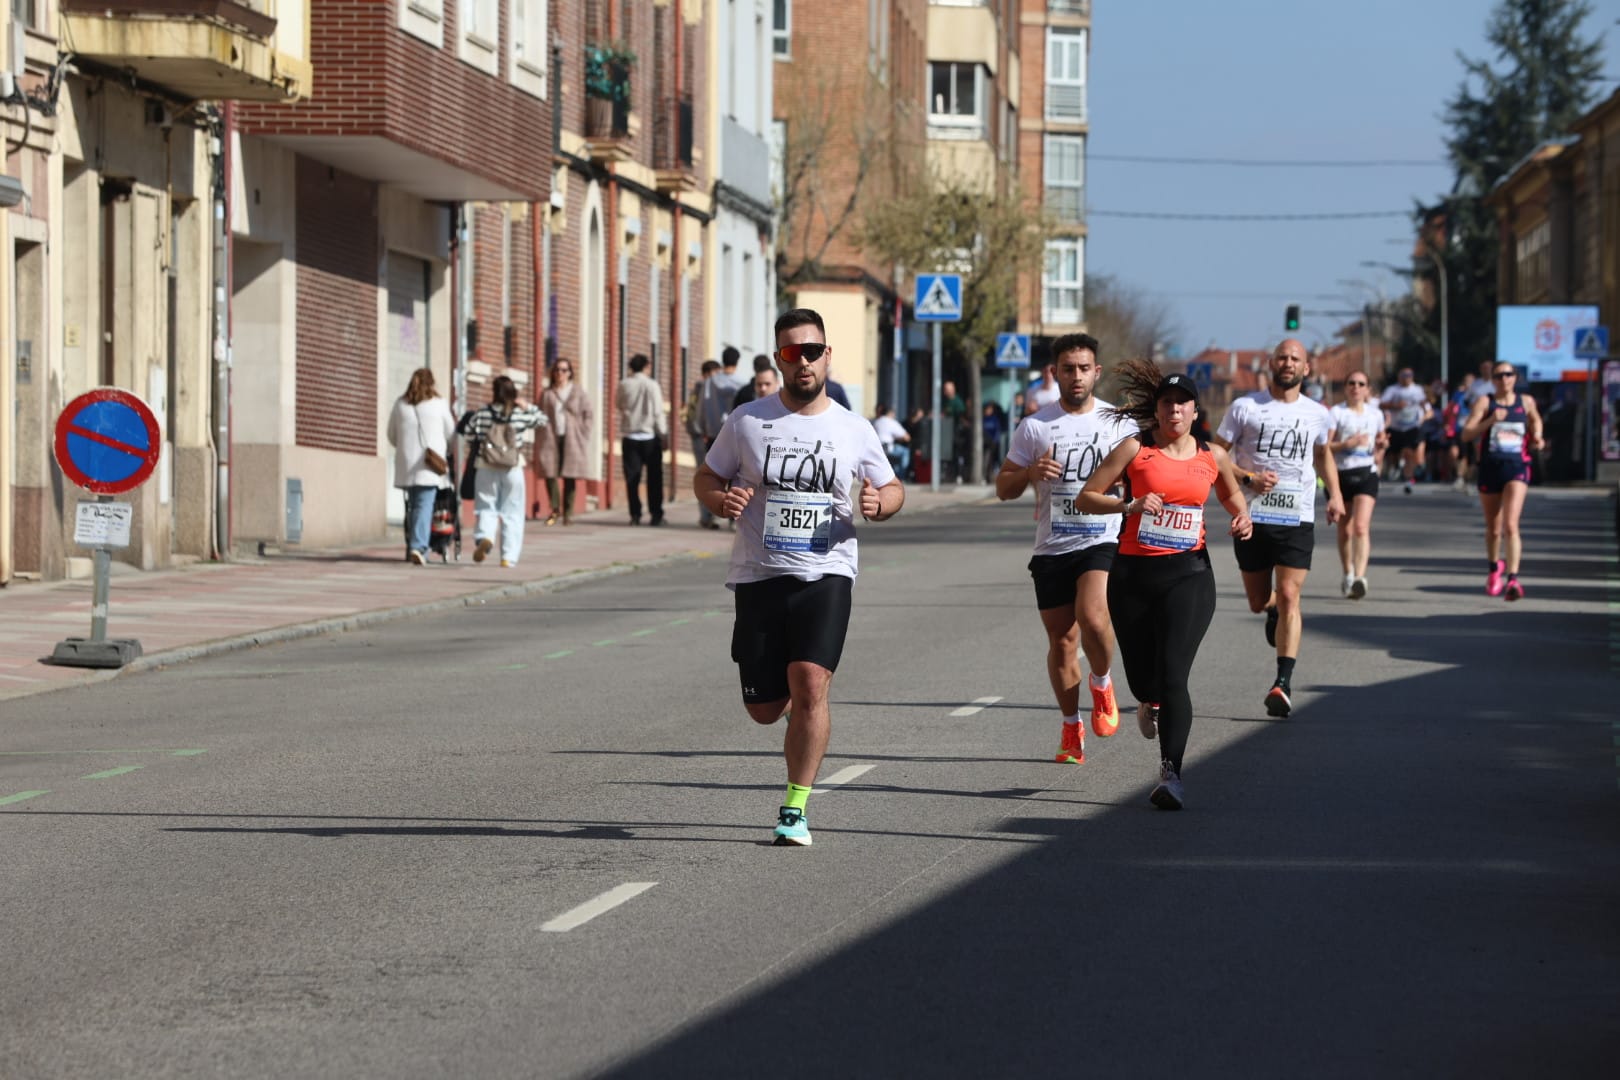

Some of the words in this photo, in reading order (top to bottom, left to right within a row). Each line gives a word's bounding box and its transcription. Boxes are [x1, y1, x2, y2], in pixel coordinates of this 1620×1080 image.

[1256, 418, 1309, 461] LEÓN
[762, 439, 837, 492] LEÓN
[1261, 491, 1295, 509] 3583
[779, 507, 818, 530] 3621
[1152, 507, 1193, 531] 3709
